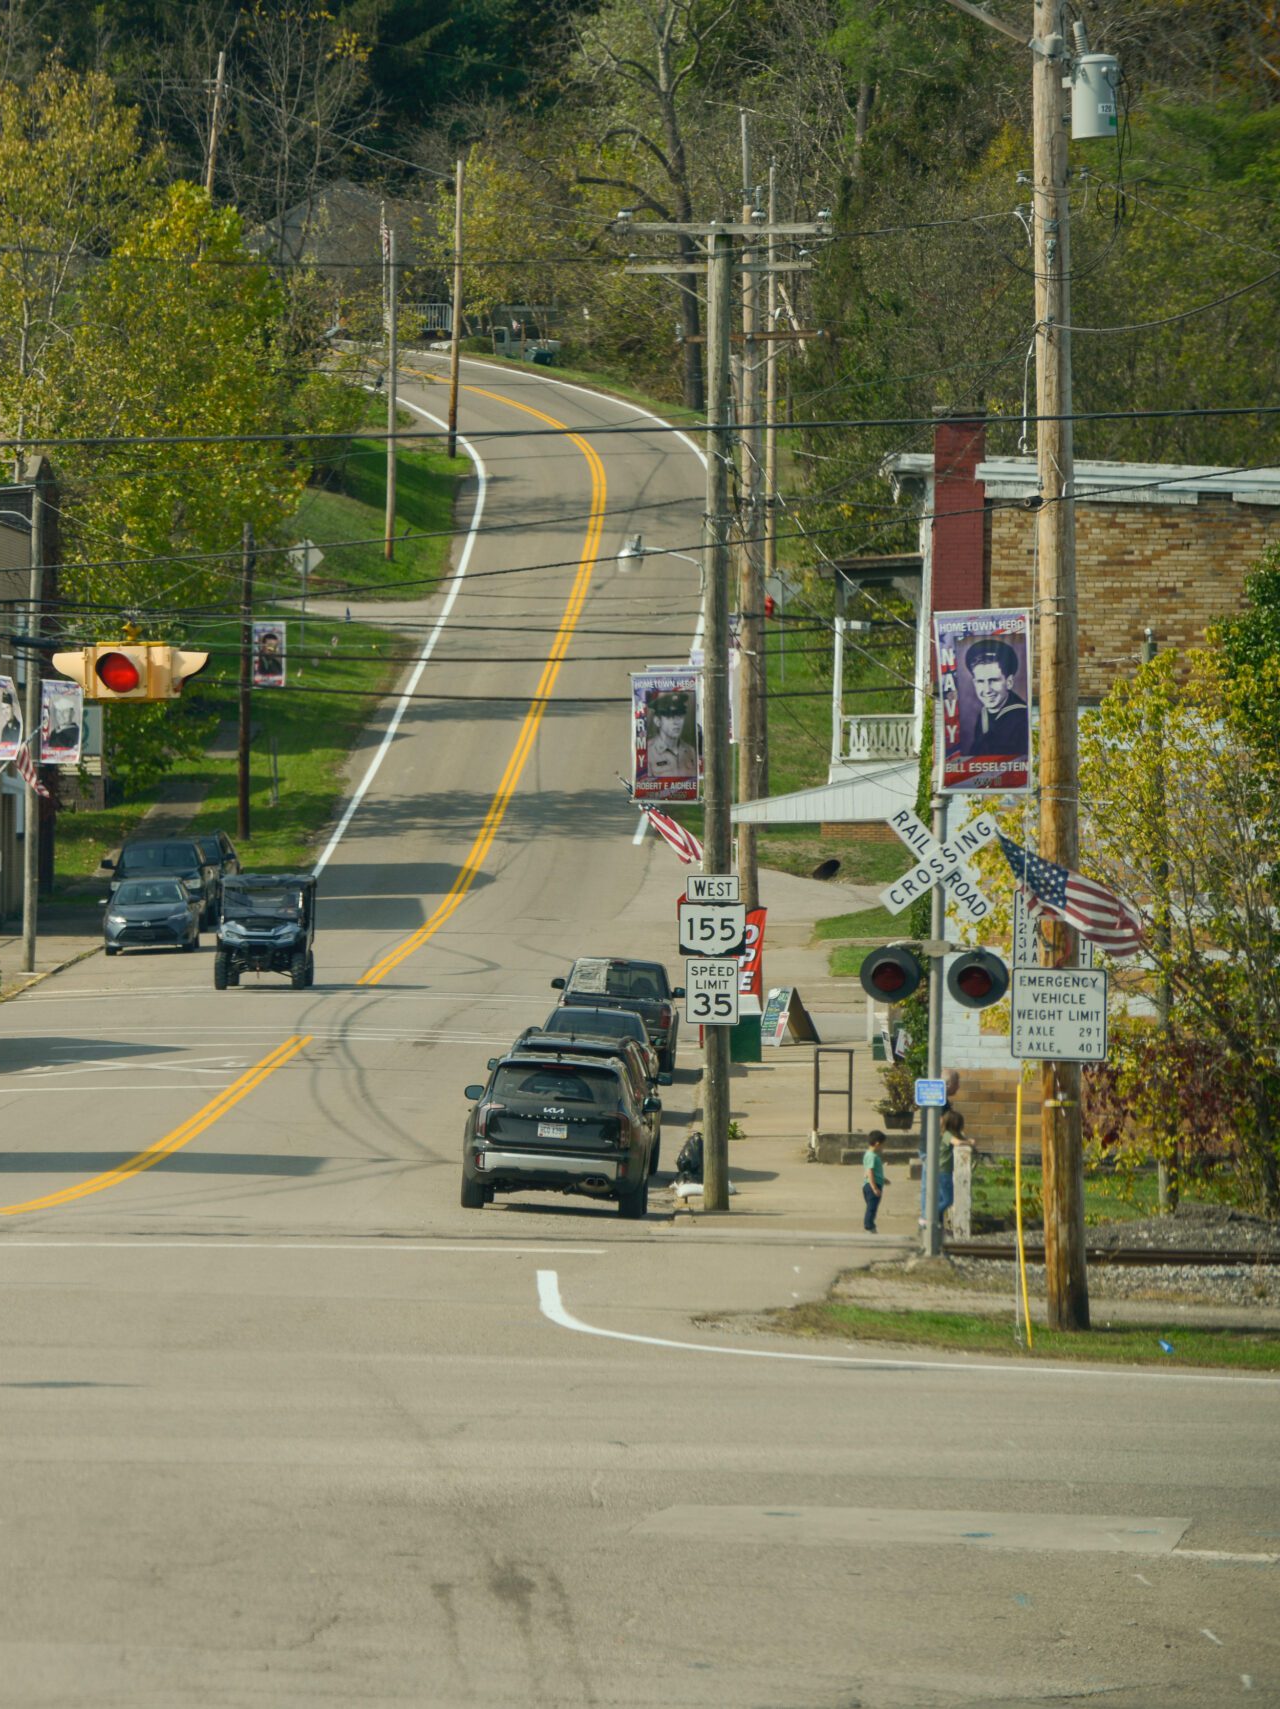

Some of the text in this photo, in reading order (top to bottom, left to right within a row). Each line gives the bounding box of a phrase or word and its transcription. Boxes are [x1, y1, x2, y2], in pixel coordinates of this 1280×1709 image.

[939, 619, 1025, 633] HOMETOWN HERO
[634, 679, 675, 689] HOMETOWN
[941, 648, 958, 743] NAVY
[636, 701, 647, 768] ARMY
[945, 761, 1029, 773] BILL ESSELSTEIN
[636, 781, 662, 790] ROBERT
[890, 821, 991, 905] CROSSING
[892, 810, 987, 917] RAIL ROAD
[694, 880, 732, 897] WEST
[687, 917, 736, 942] 155
[738, 924, 760, 991] OPE
[691, 966, 735, 977] SPEED
[695, 980, 730, 990] LIMIT
[1019, 976, 1099, 989] EMERGENCY
[693, 992, 733, 1017] 35
[1032, 992, 1087, 1005] VEHICLE
[1017, 1009, 1102, 1022] WEIGHT LIMIT
[1028, 1026, 1056, 1037] AXLE
[1079, 1027, 1092, 1038] 29
[1096, 1027, 1102, 1038] T
[1028, 1041, 1055, 1053] AXLE
[1078, 1043, 1093, 1054] 40
[1097, 1043, 1103, 1054] T
[520, 1113, 587, 1122] TELLURIDE
